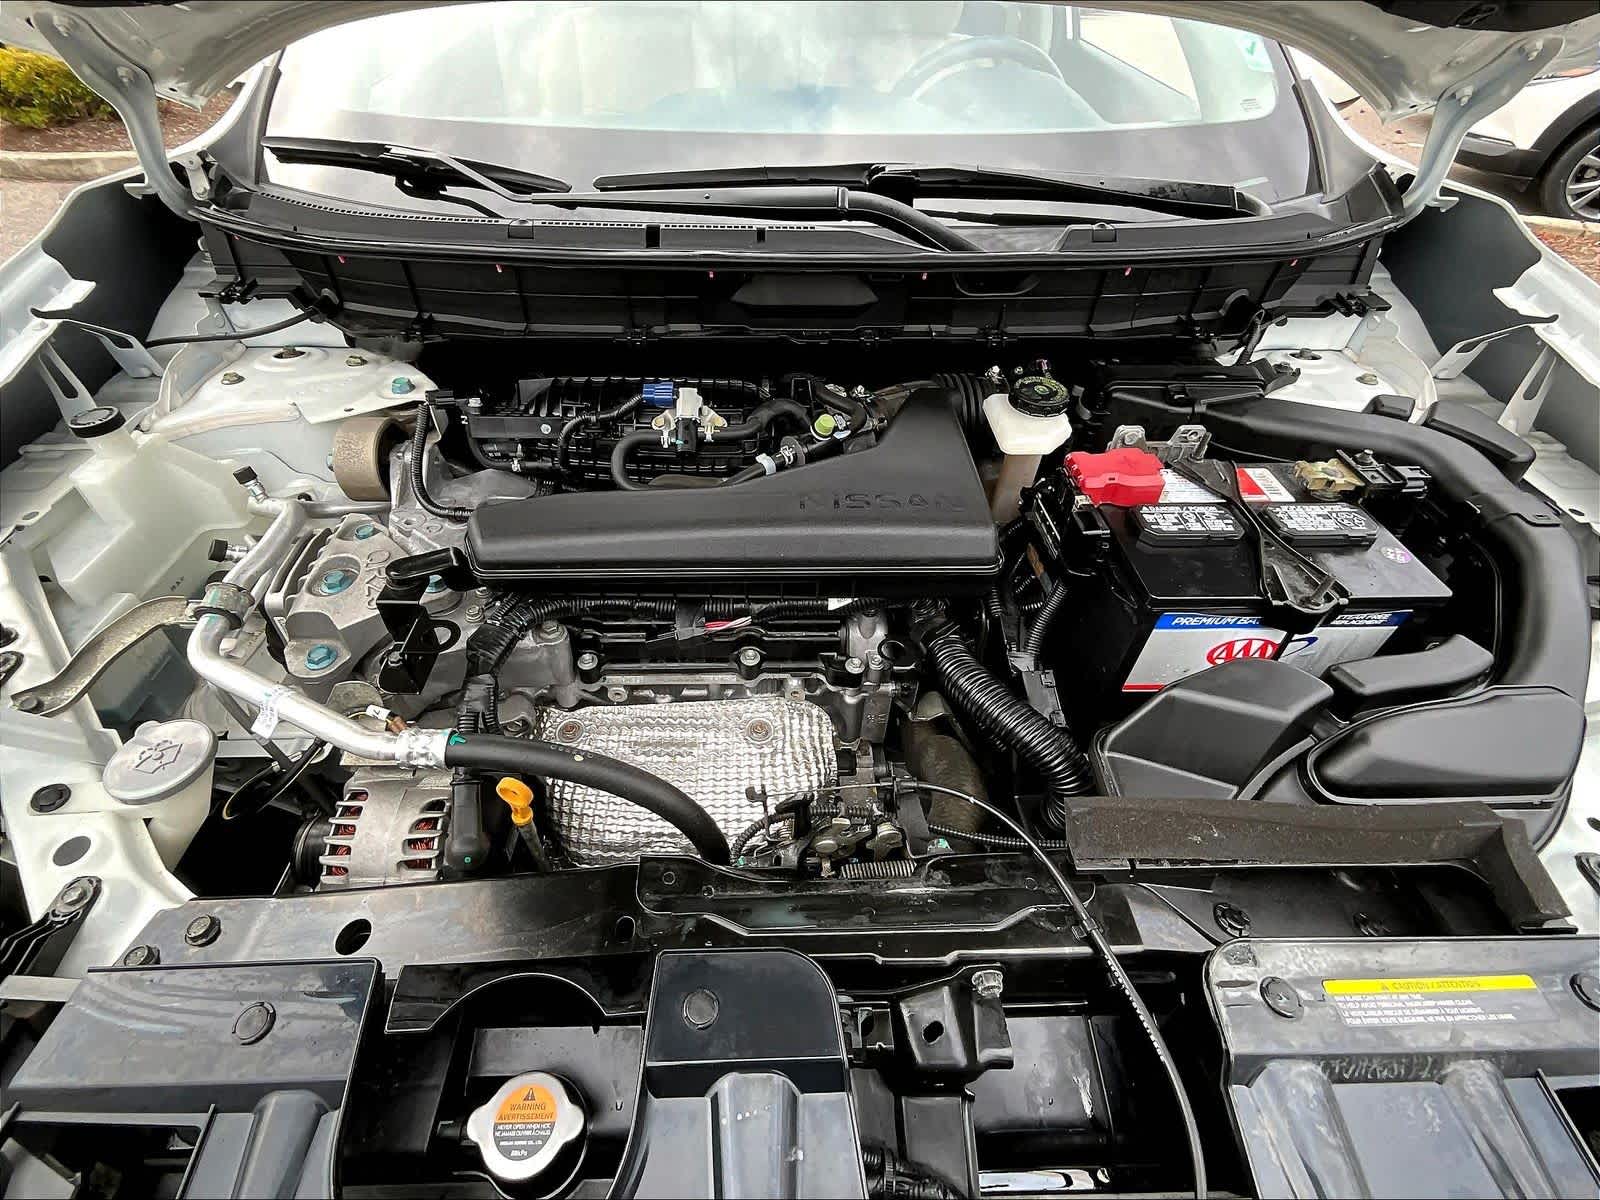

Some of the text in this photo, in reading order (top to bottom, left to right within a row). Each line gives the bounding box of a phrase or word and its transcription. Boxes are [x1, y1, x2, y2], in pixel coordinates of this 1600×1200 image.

[799, 492, 967, 512] NISSAN
[1171, 616, 1235, 626] PREMIUM
[1213, 639, 1272, 663] AAA
[510, 1102, 547, 1111] WARNING
[497, 1112, 554, 1121] AVERTISSEMENT
